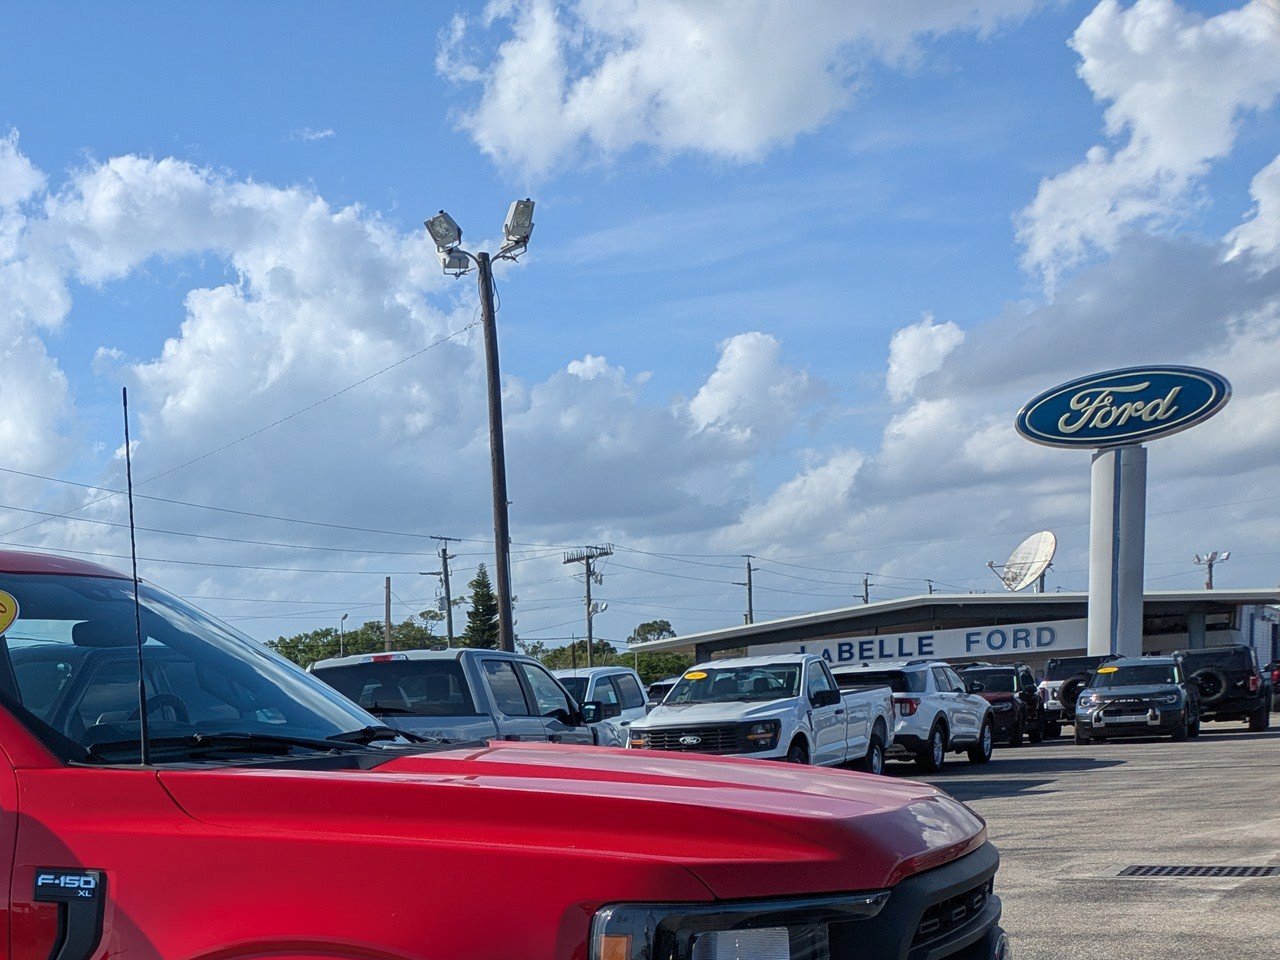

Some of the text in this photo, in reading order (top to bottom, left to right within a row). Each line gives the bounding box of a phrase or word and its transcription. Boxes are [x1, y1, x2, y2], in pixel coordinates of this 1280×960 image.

[1058, 381, 1182, 433] Ford
[965, 626, 1056, 652] FORD
[37, 874, 96, 889] F-150
